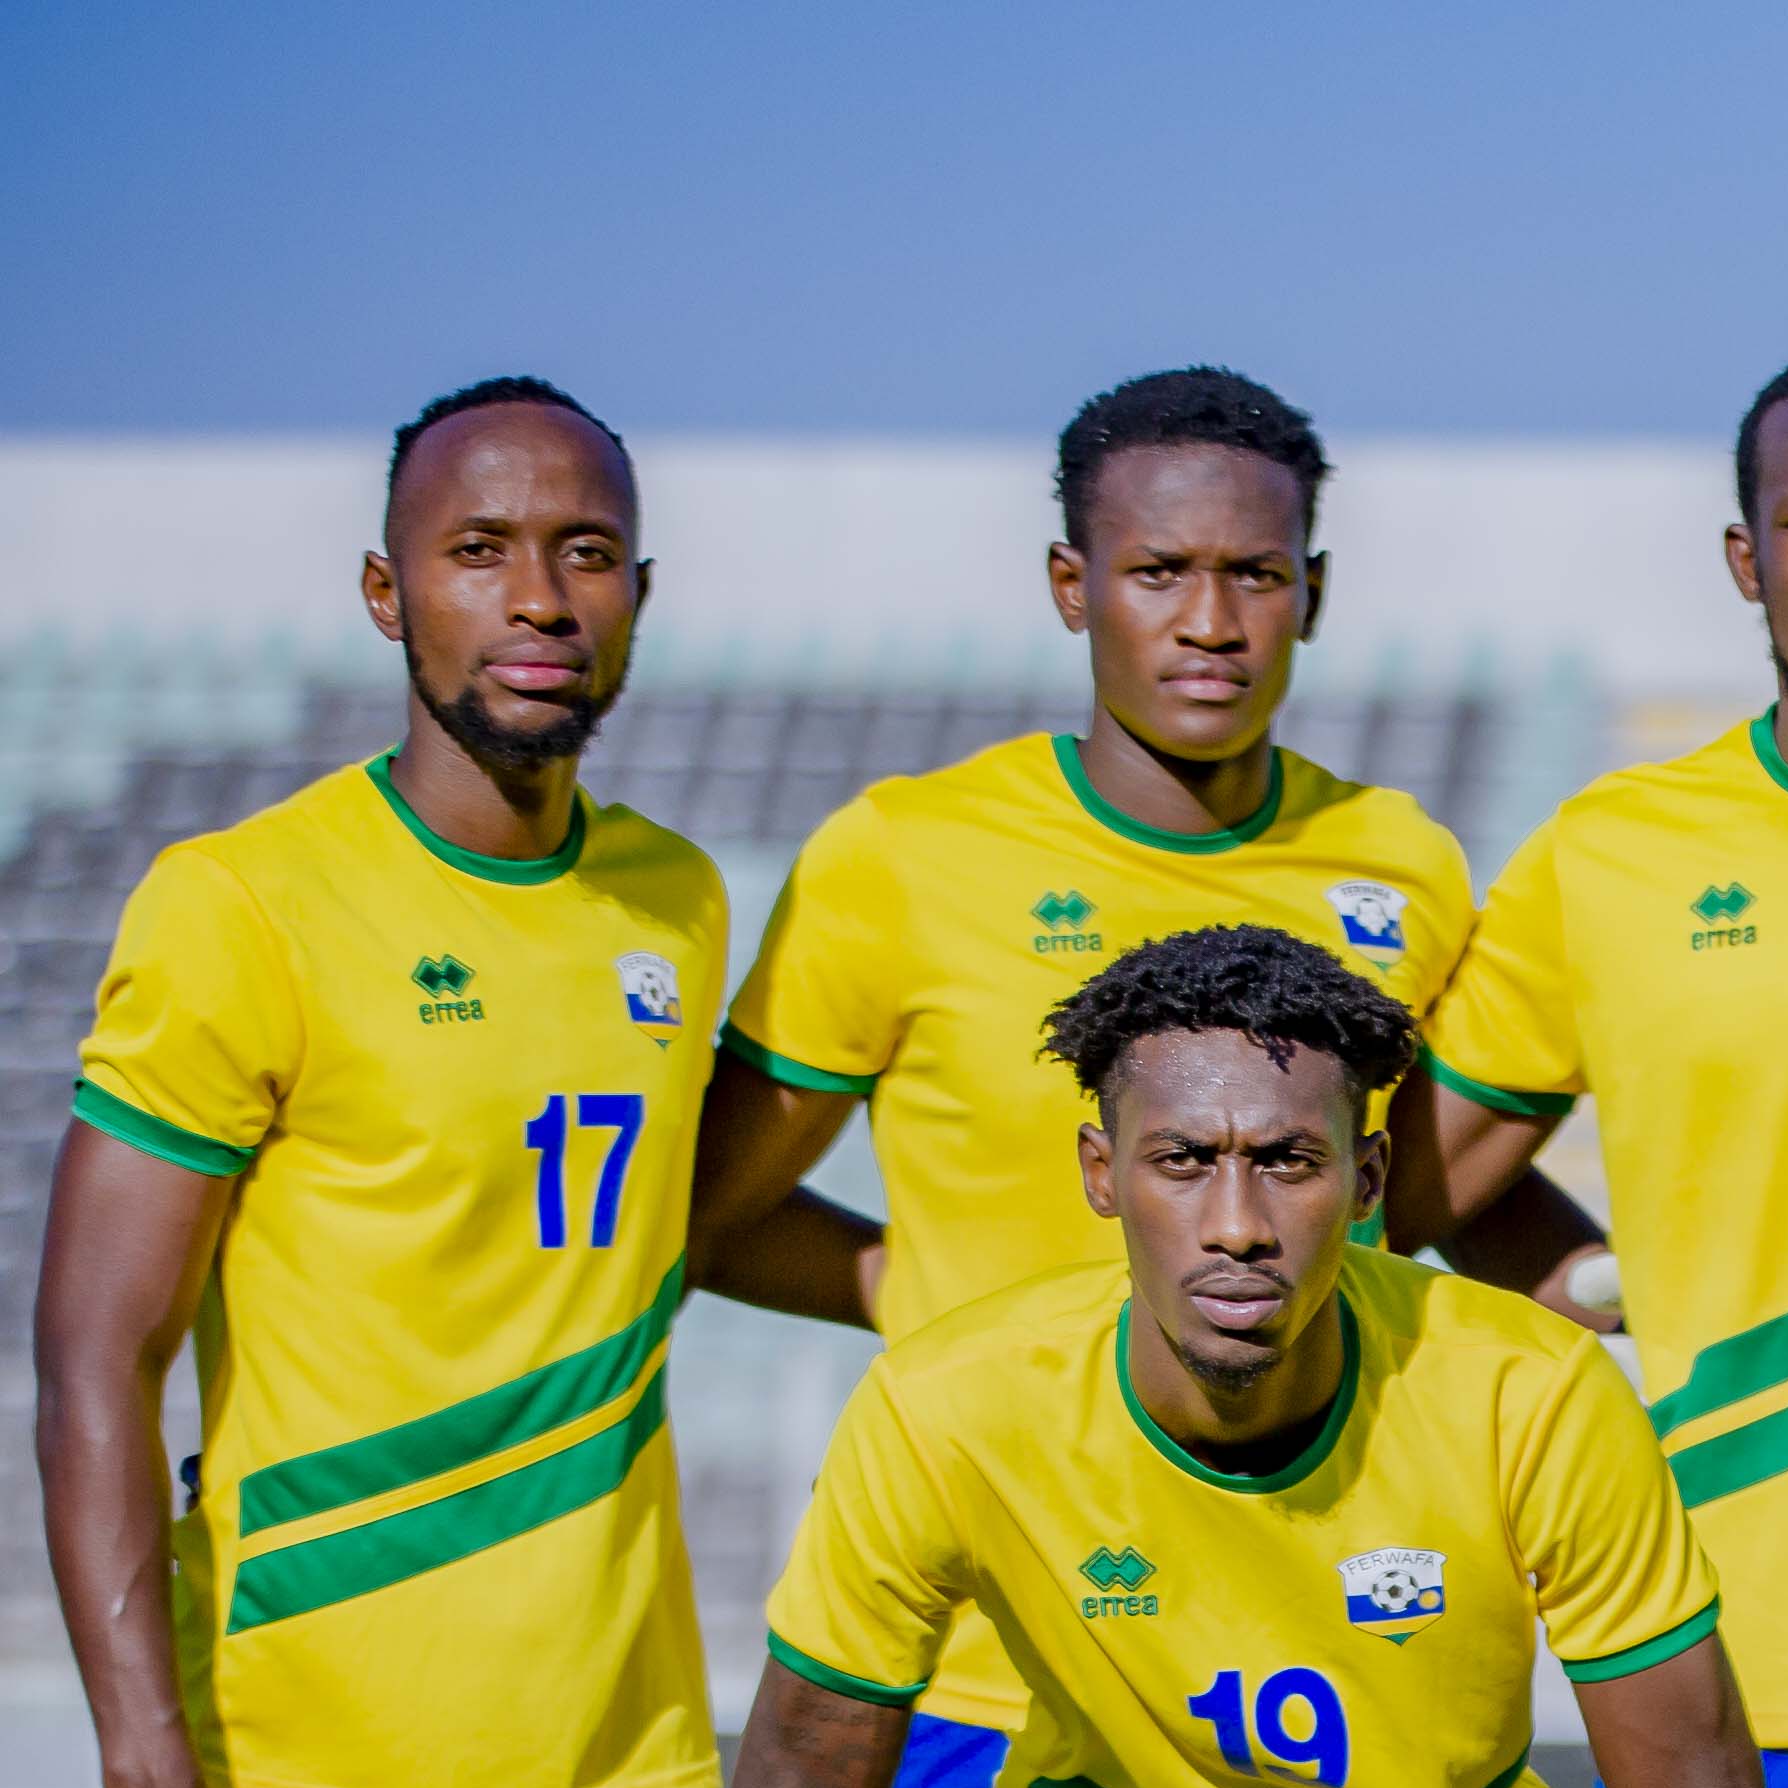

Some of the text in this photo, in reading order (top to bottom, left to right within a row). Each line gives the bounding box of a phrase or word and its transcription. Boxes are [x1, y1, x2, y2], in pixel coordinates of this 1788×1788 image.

[1034, 932, 1103, 953] errea
[1691, 923, 1758, 951] errea
[417, 998, 486, 1025] errea
[523, 1092, 646, 1249] 17
[1345, 1551, 1435, 1576] FERWAFA
[1081, 1593, 1159, 1620] errea
